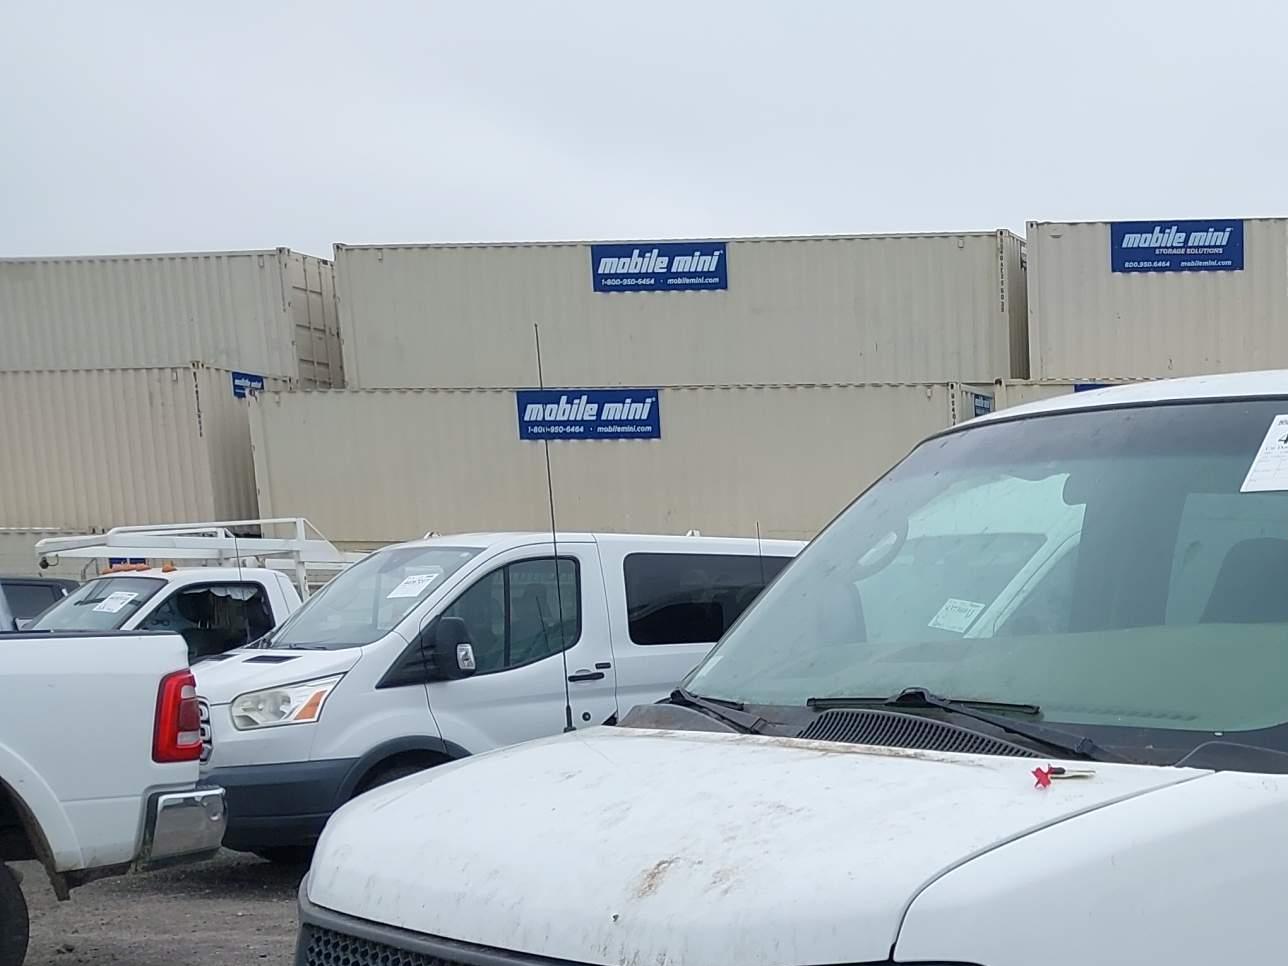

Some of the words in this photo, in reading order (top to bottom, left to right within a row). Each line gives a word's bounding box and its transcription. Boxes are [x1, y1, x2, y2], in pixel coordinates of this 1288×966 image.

[1122, 226, 1186, 248] mobile
[1188, 227, 1231, 247] mini
[1186, 247, 1223, 255] SOLUTIONS
[598, 249, 669, 274] mobile
[671, 251, 720, 273] mini
[667, 276, 719, 285] mobilemini.com
[524, 395, 598, 421] mobile
[601, 398, 652, 420] mini
[597, 424, 652, 433] mobilemini.com
